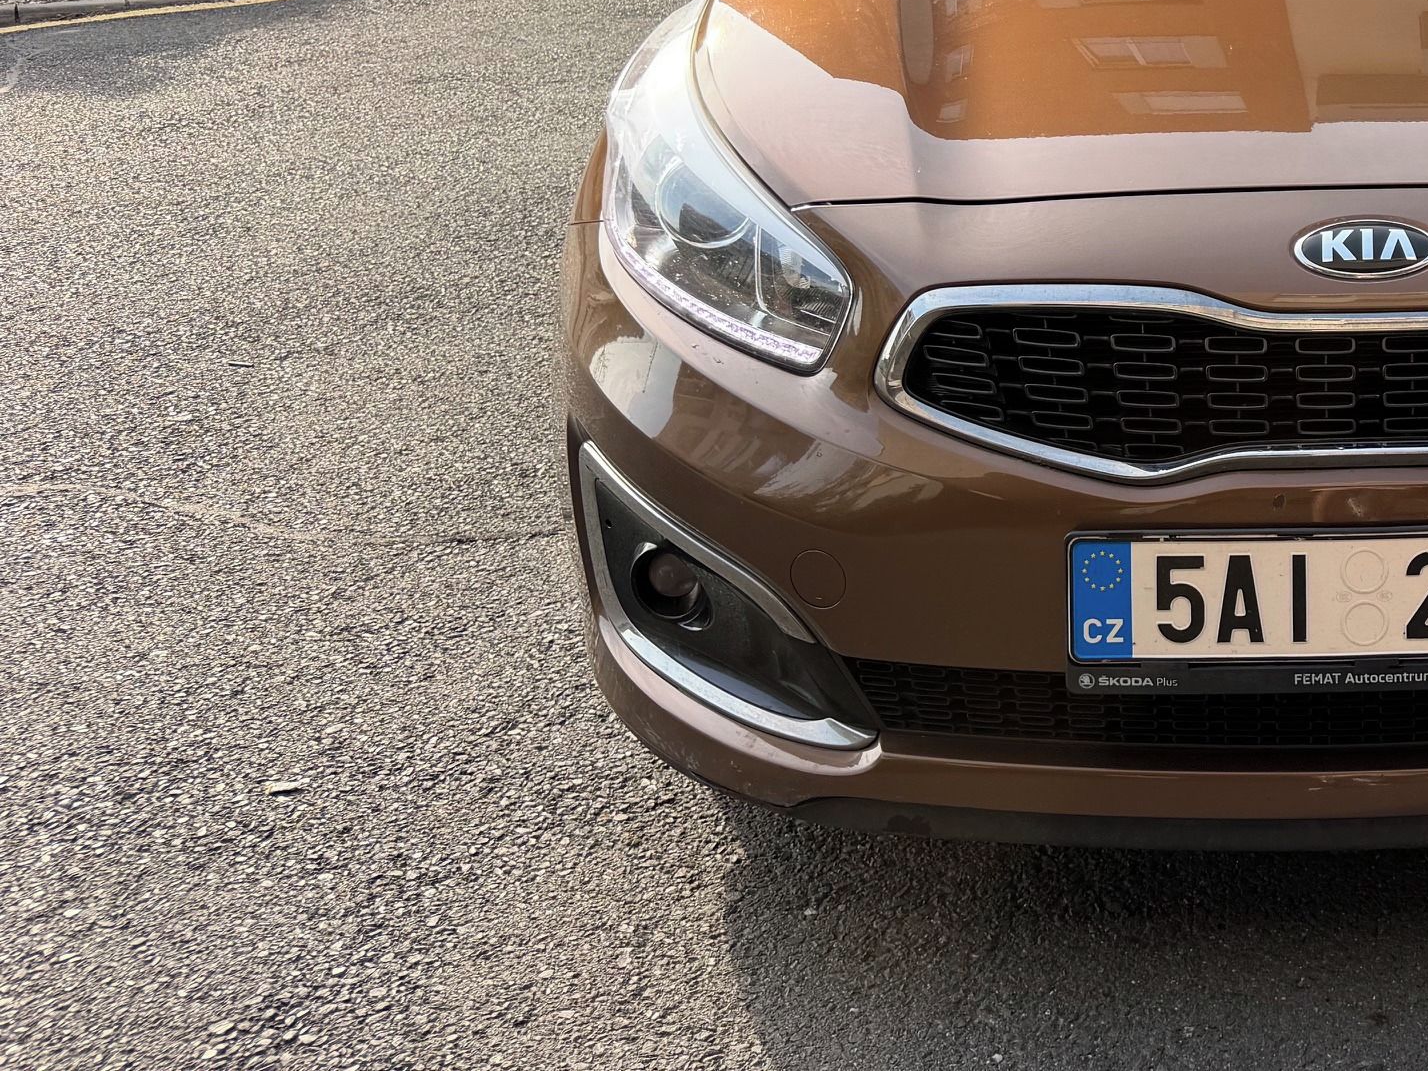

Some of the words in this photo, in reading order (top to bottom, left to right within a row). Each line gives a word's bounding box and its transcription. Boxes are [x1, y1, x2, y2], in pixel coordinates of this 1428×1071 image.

[1320, 228, 1417, 262] KIA
[1156, 553, 1307, 644] 5AI
[1083, 618, 1124, 645] CZ
[1098, 674, 1154, 686] ŠKODA
[1156, 677, 1178, 687] Plus
[1294, 673, 1341, 685] FEMAT
